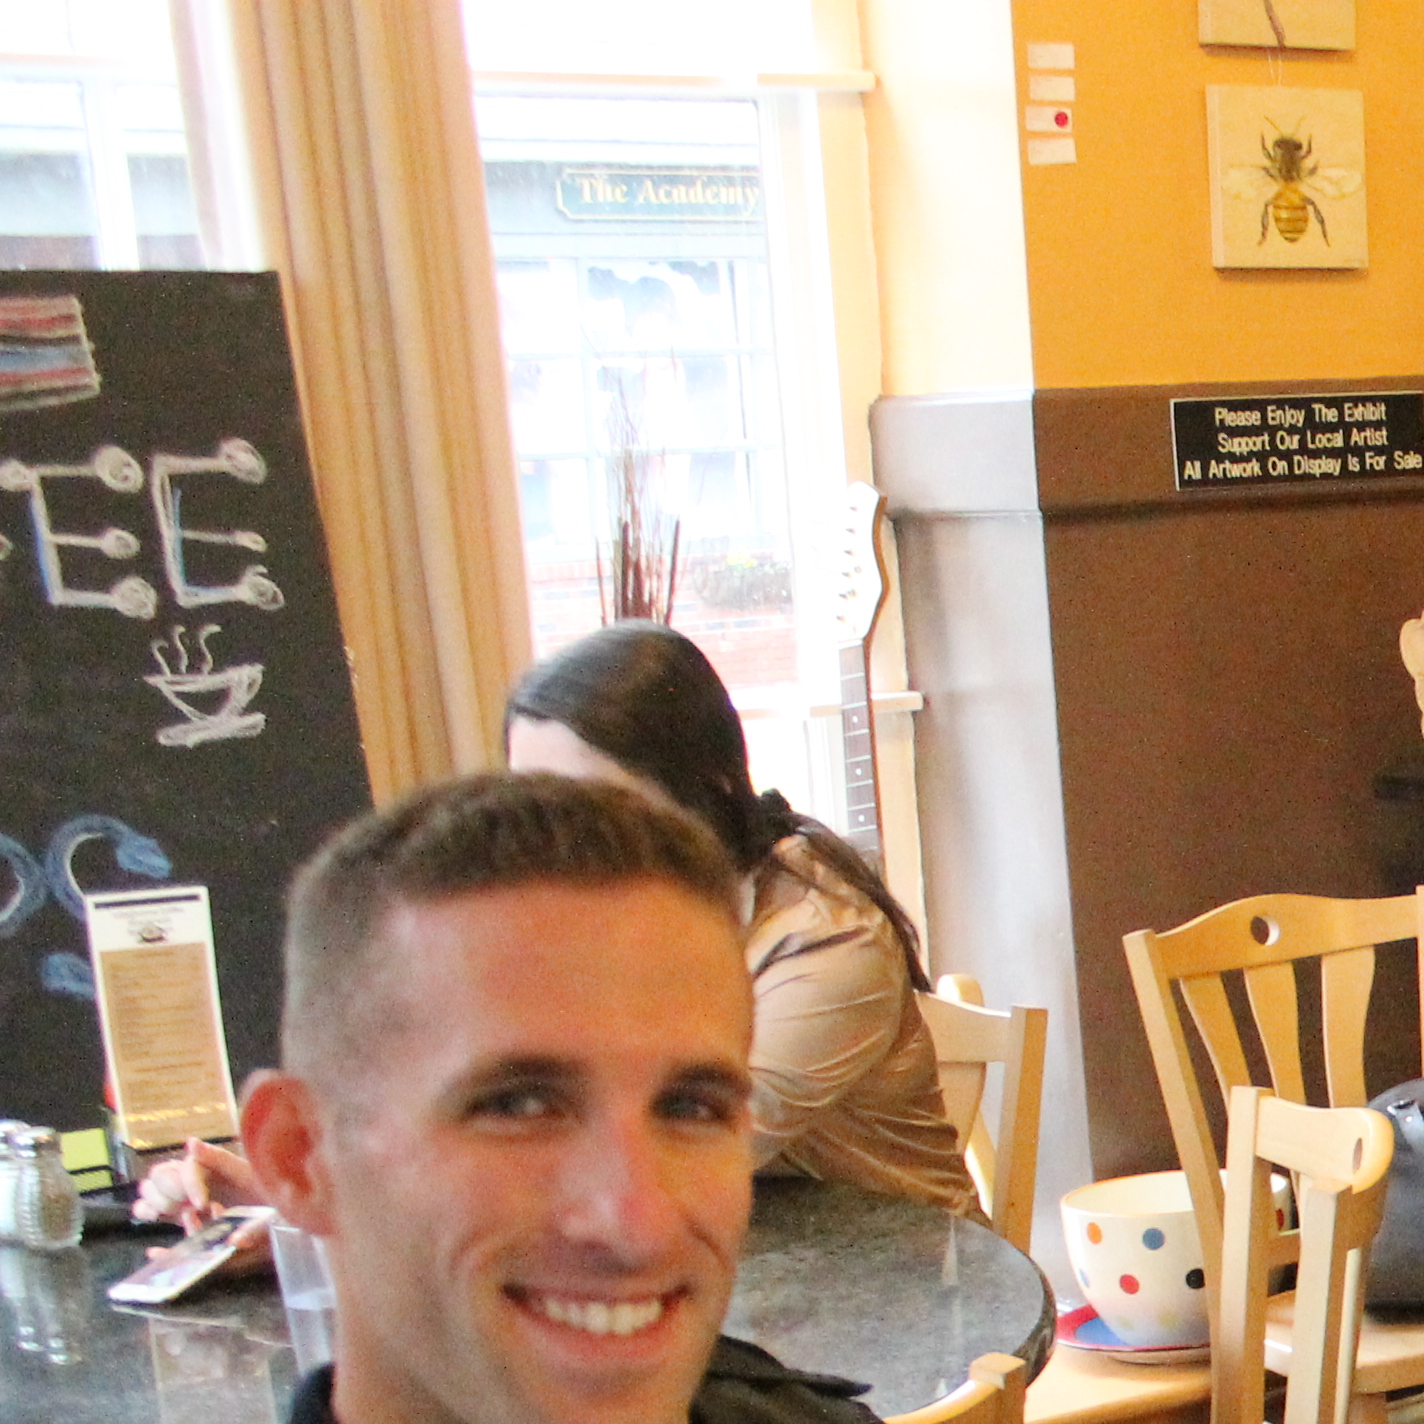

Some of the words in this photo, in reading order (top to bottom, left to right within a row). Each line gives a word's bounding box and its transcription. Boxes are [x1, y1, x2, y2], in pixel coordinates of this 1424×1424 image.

[578, 178, 628, 204] The
[637, 175, 760, 217] Academy
[1213, 406, 1262, 428] Please
[1266, 404, 1306, 429] Enjoy
[1311, 402, 1339, 424] The
[1343, 401, 1387, 423] Exhibit
[1217, 431, 1270, 458] Support
[1275, 429, 1301, 451] Our
[1306, 428, 1344, 449] Local
[1350, 426, 1389, 447] Artist
[1183, 460, 1202, 481] All
[1208, 458, 1263, 480] Artwork
[1267, 457, 1289, 477] On
[1293, 455, 1343, 477] Display
[1347, 453, 1361, 473] Is
[1364, 451, 1387, 471] For
[1393, 449, 1424, 470] Sale
[0, 436, 284, 621] EE
